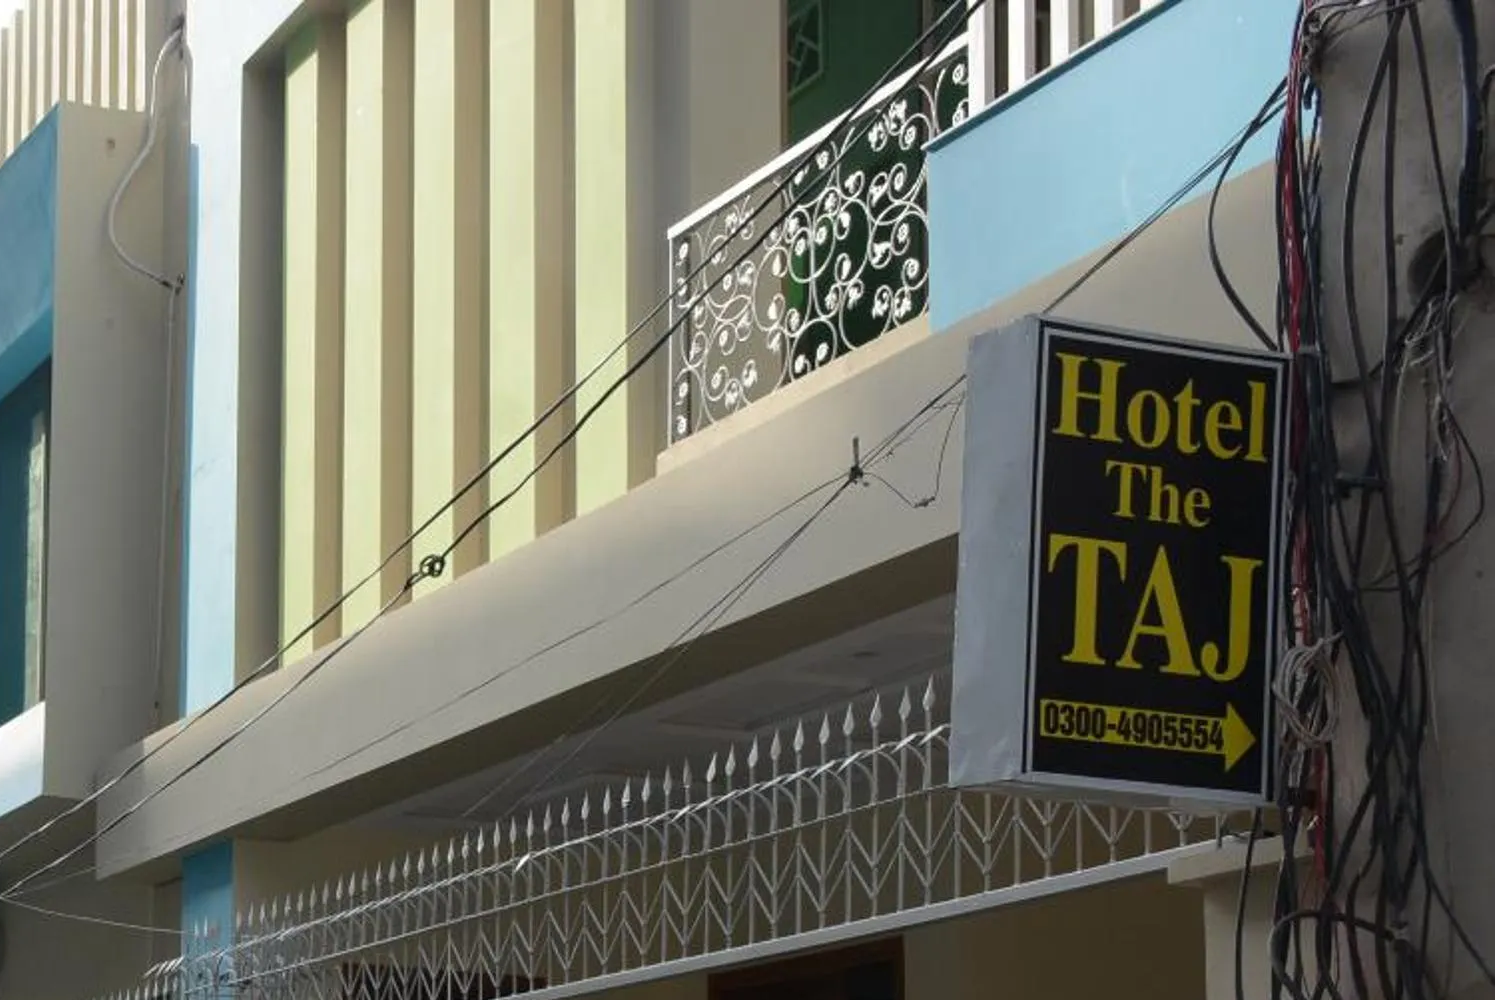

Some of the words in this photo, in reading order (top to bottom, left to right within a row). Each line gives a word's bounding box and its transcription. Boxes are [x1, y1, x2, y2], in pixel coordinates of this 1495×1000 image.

[1052, 351, 1269, 462] Hotel
[1105, 460, 1212, 527] The
[1047, 533, 1263, 682] TAJ
[1043, 702, 1225, 751] 0300-4905554
